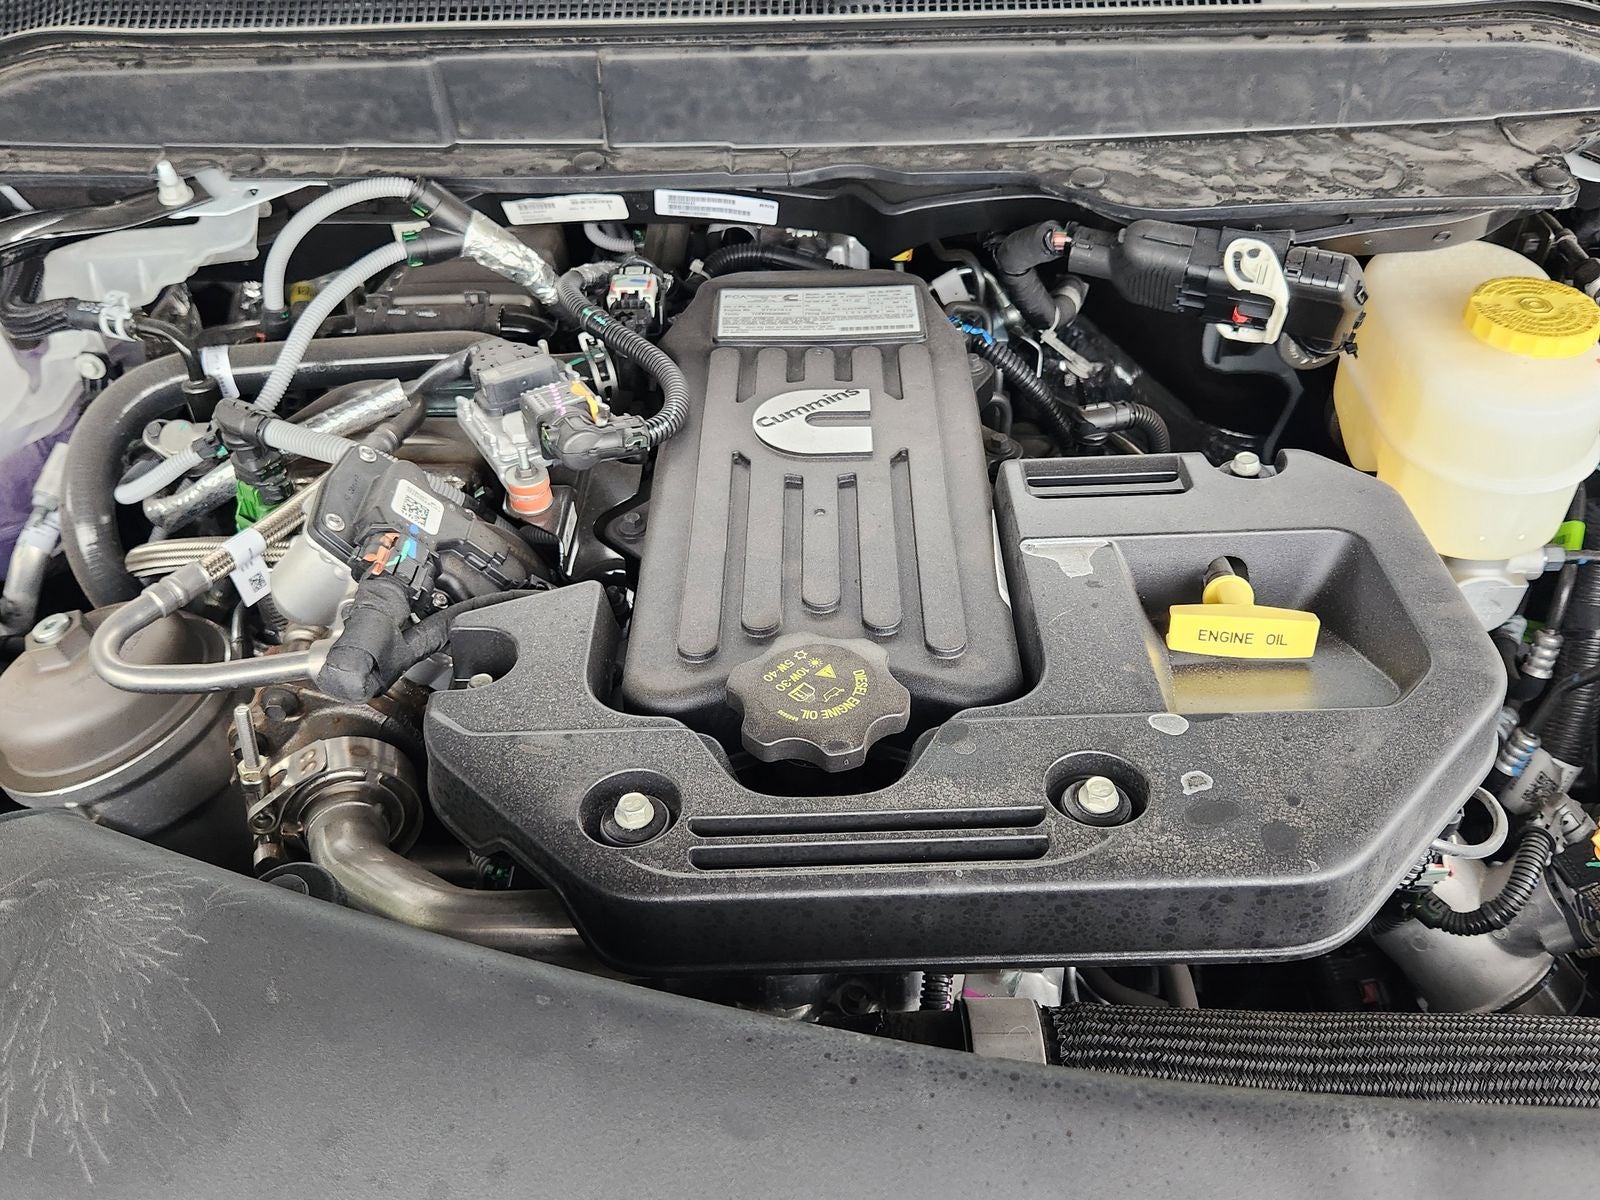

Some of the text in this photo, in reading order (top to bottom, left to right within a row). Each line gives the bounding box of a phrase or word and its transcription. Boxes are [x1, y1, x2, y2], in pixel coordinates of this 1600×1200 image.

[756, 388, 860, 427] Cummins
[1198, 629, 1288, 646] ENGINE OIL
[763, 659, 795, 682] 5W-40
[775, 666, 810, 692] 10W-30
[852, 669, 869, 696] DIESEL
[800, 709, 819, 720] OIL
[821, 696, 861, 719] ENGINE
